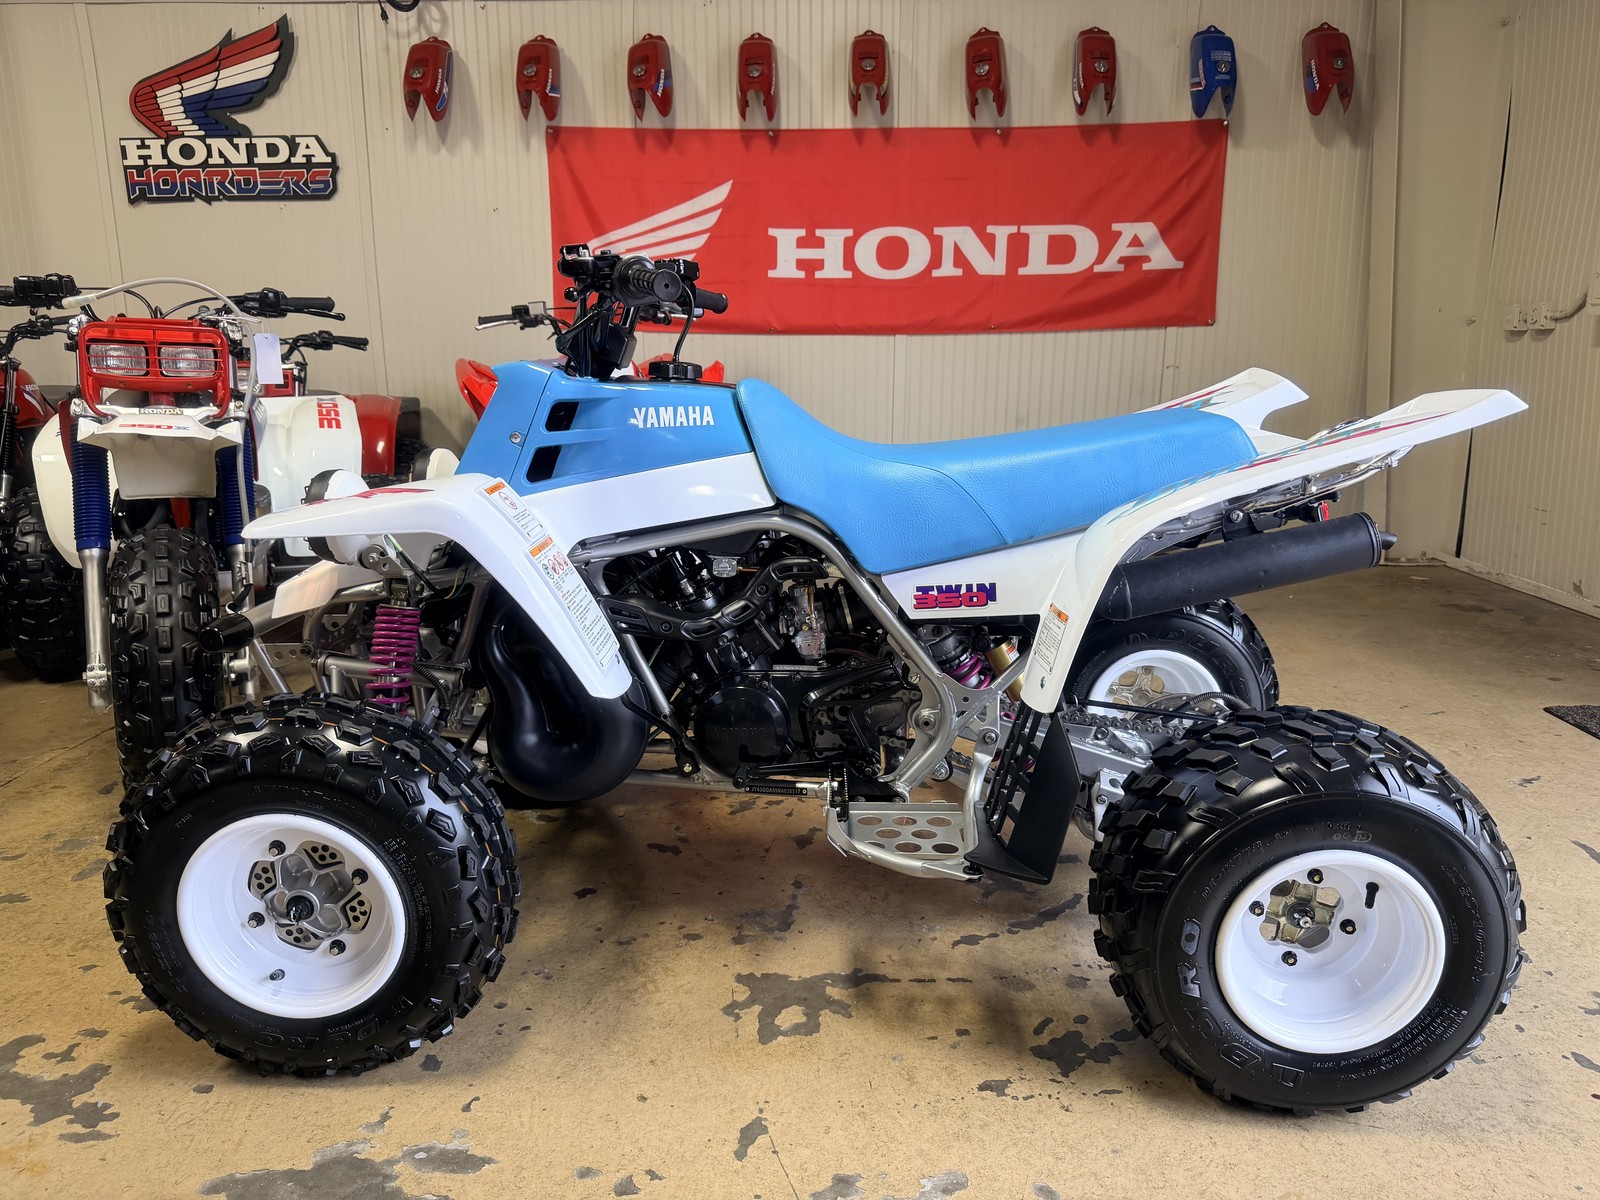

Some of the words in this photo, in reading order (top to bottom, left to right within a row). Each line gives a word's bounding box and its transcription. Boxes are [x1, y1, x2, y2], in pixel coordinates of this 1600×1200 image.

[435, 68, 443, 95] HONDA
[545, 68, 553, 94] HONDA
[656, 68, 666, 98] HONDA
[1310, 58, 1320, 91] HONDA
[120, 137, 332, 166] HONDA
[126, 166, 333, 199] HOARDERS
[767, 221, 1184, 280] HONDA
[633, 405, 715, 428] YAMAHA
[913, 591, 988, 609] 350
[915, 582, 997, 602] TWIN
[1177, 918, 1261, 1069] DURO
